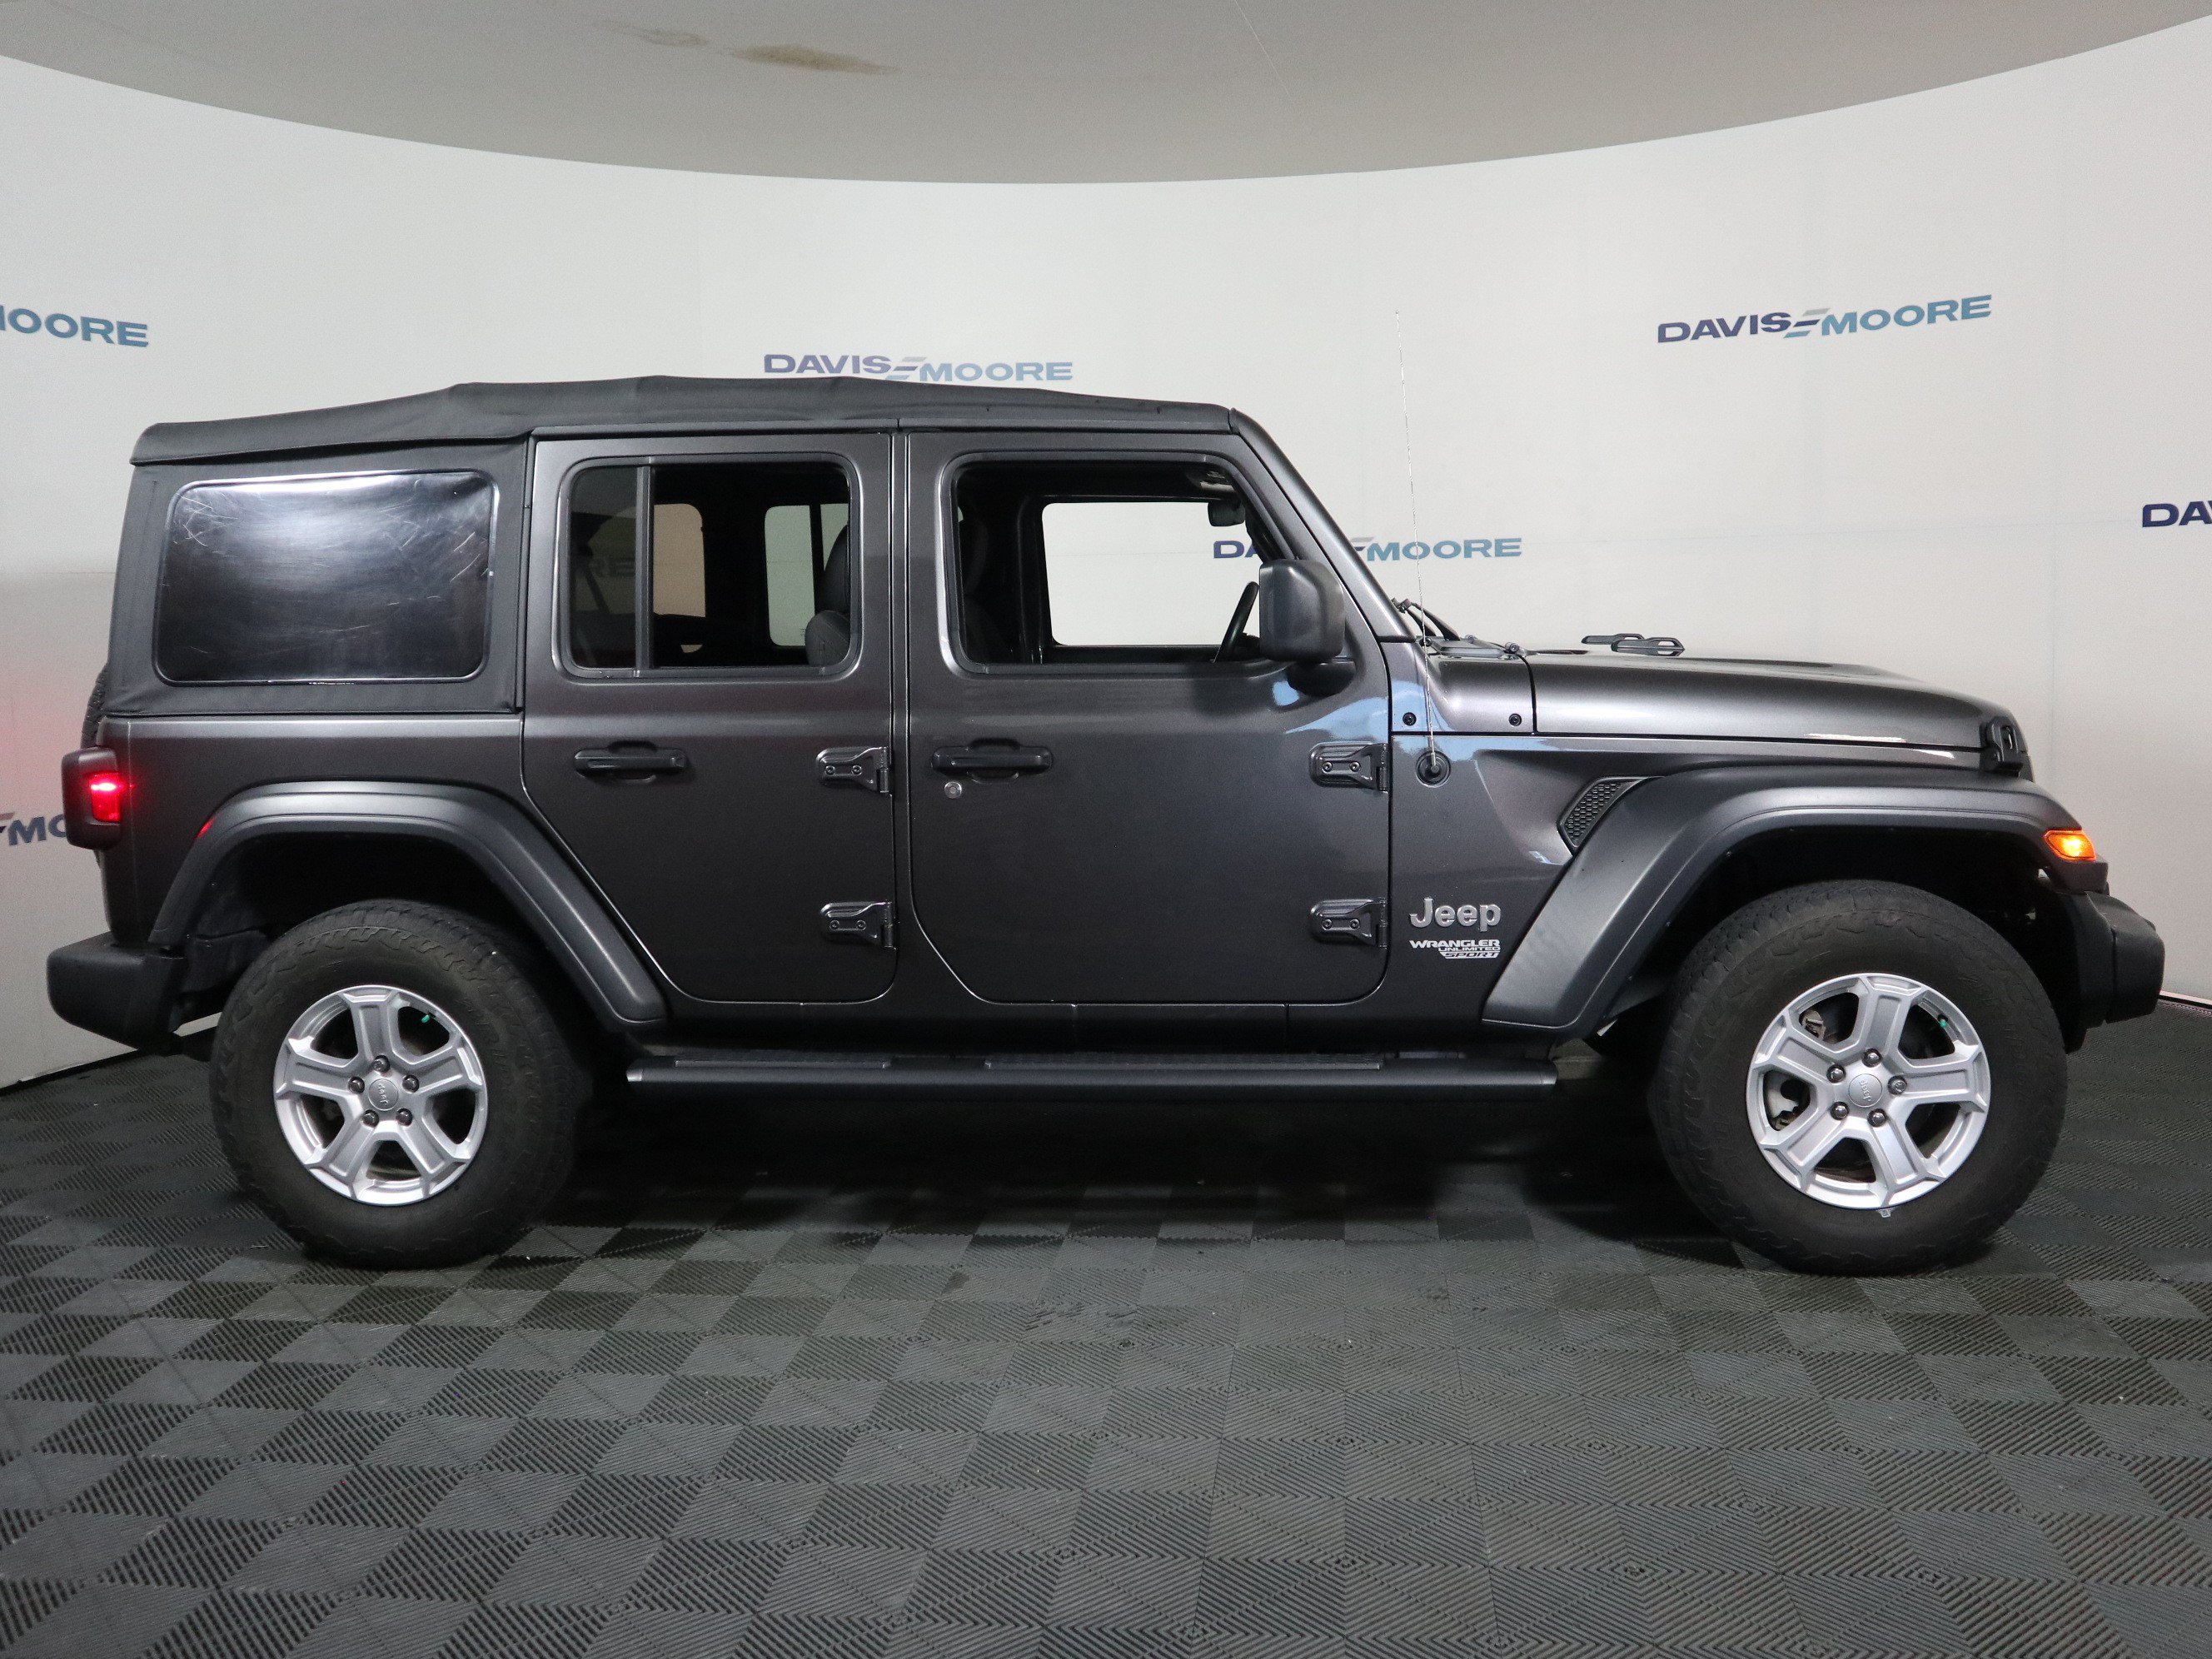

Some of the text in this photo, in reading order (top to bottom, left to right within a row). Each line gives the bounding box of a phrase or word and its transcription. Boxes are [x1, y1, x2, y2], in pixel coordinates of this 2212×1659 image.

[0, 305, 148, 347] OORE
[1657, 294, 1992, 343] DAVIS MOORE
[764, 354, 1073, 381] DAVIS MOORE
[2142, 501, 2212, 527] DA
[1367, 537, 1522, 561] MOORE
[1409, 896, 1501, 932] Jeep
[1409, 939, 1500, 949] WRANGLER
